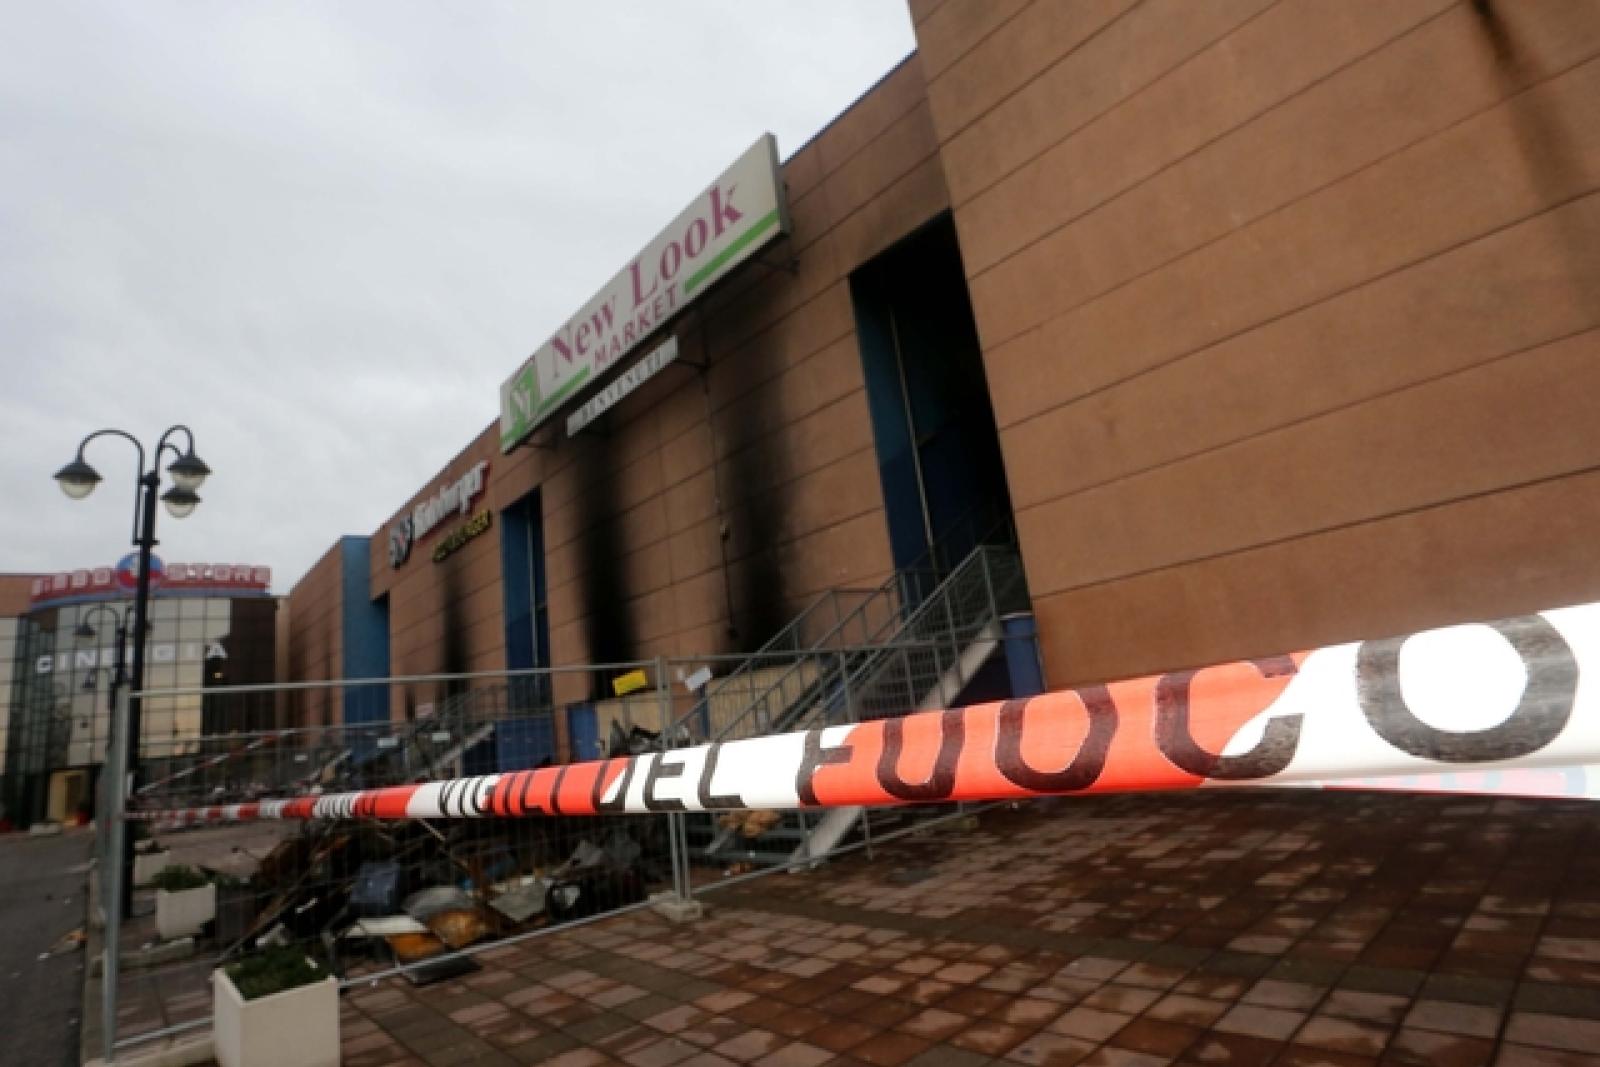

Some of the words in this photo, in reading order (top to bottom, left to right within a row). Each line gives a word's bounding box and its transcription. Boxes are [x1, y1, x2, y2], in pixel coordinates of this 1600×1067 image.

[550, 294, 617, 379] New
[629, 183, 744, 308] Look
[593, 281, 679, 371] MARKET
[796, 612, 1580, 806] FUOCO
